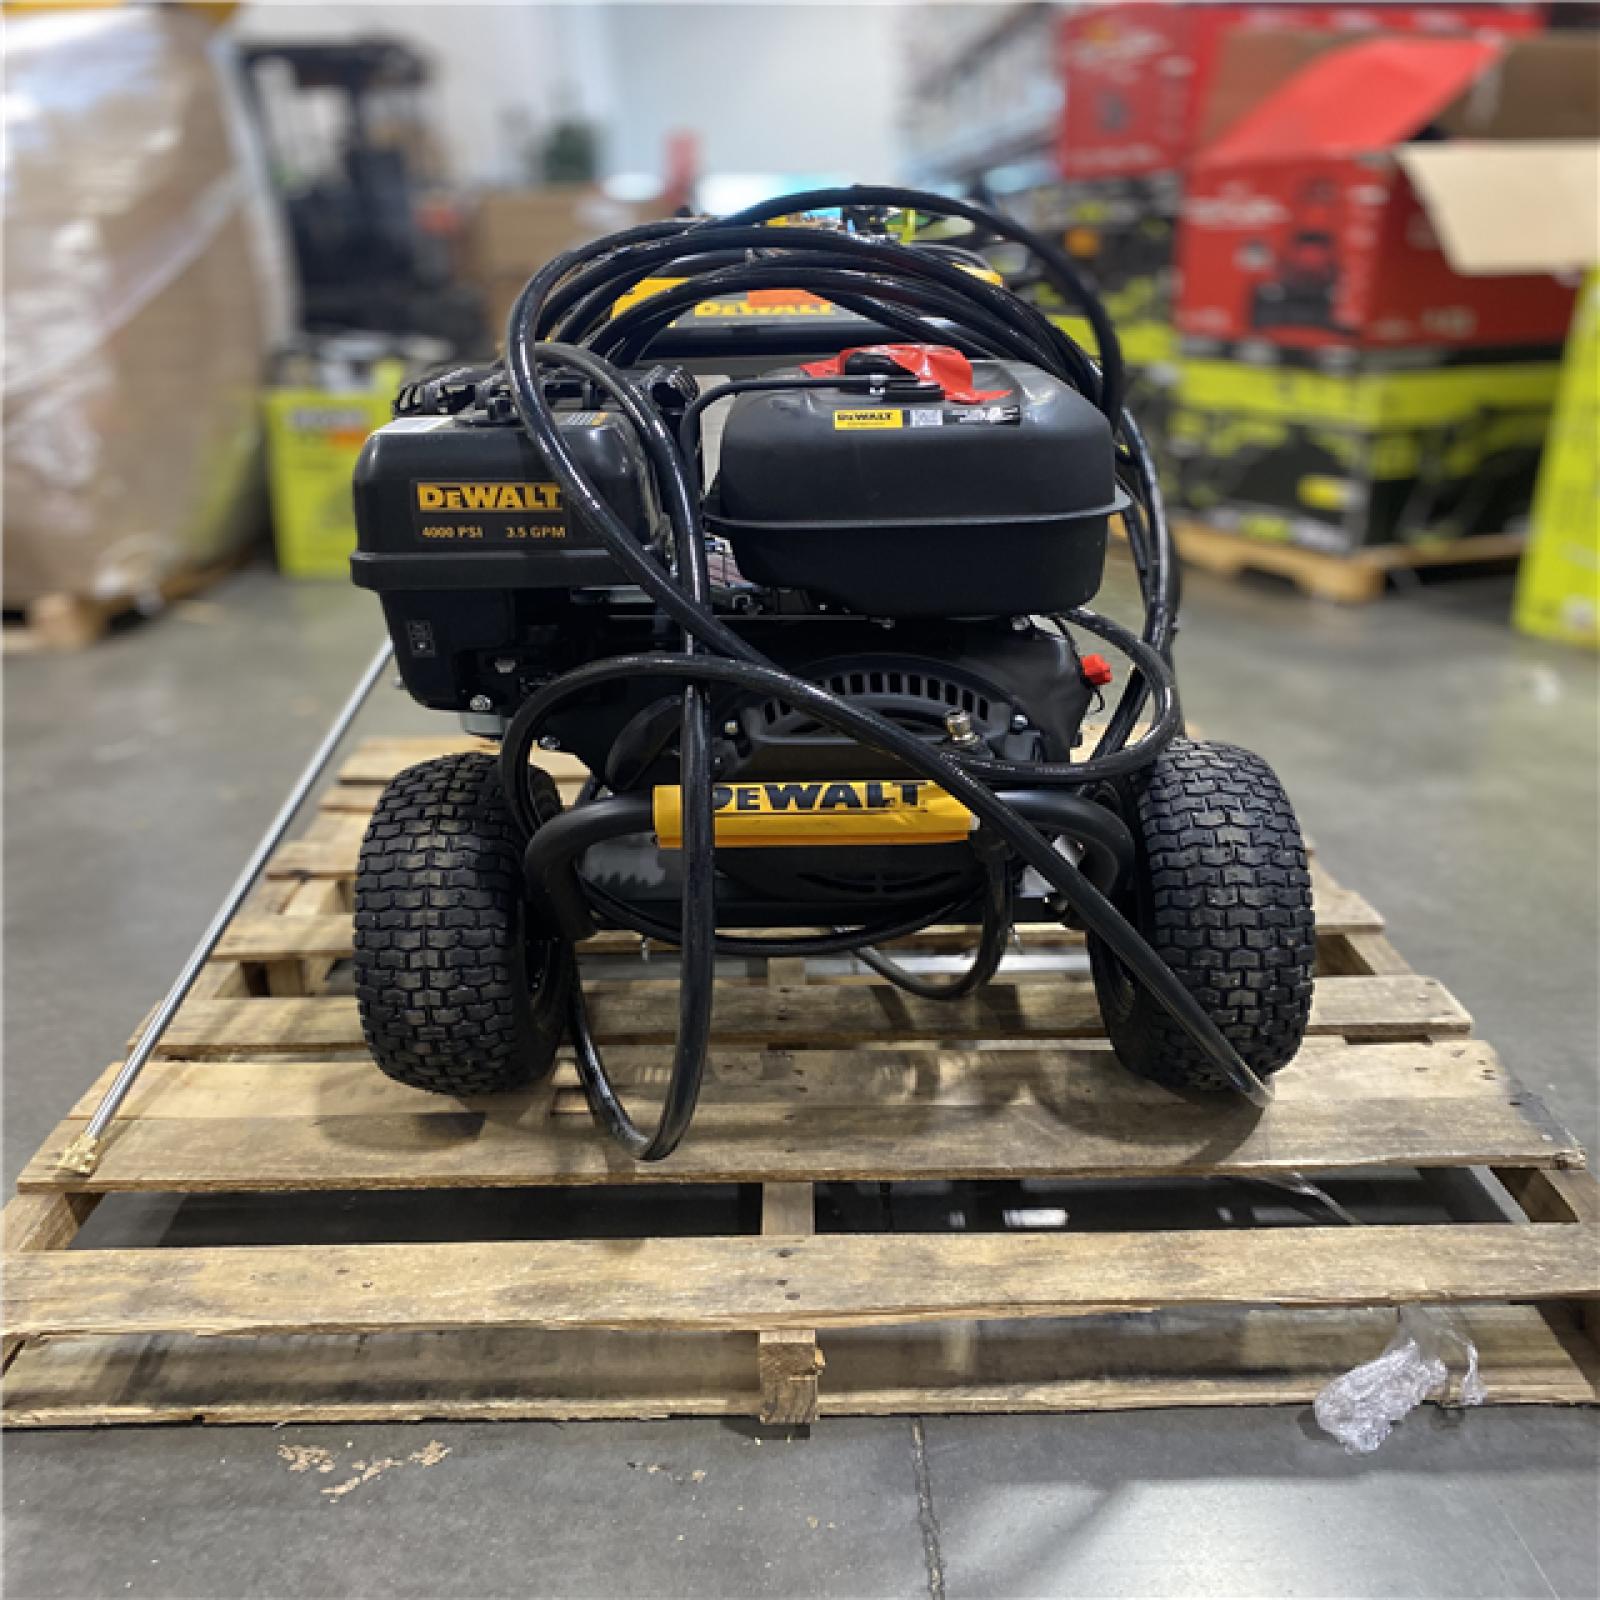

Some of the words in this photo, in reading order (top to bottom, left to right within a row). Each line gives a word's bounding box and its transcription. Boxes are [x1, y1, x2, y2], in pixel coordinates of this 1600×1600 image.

[837, 411, 893, 421] DEWALT
[418, 484, 561, 510] DEWALT
[422, 526, 455, 539] 4000
[457, 526, 484, 539] PSI
[506, 526, 528, 539] 3.5
[529, 526, 566, 539] GPM
